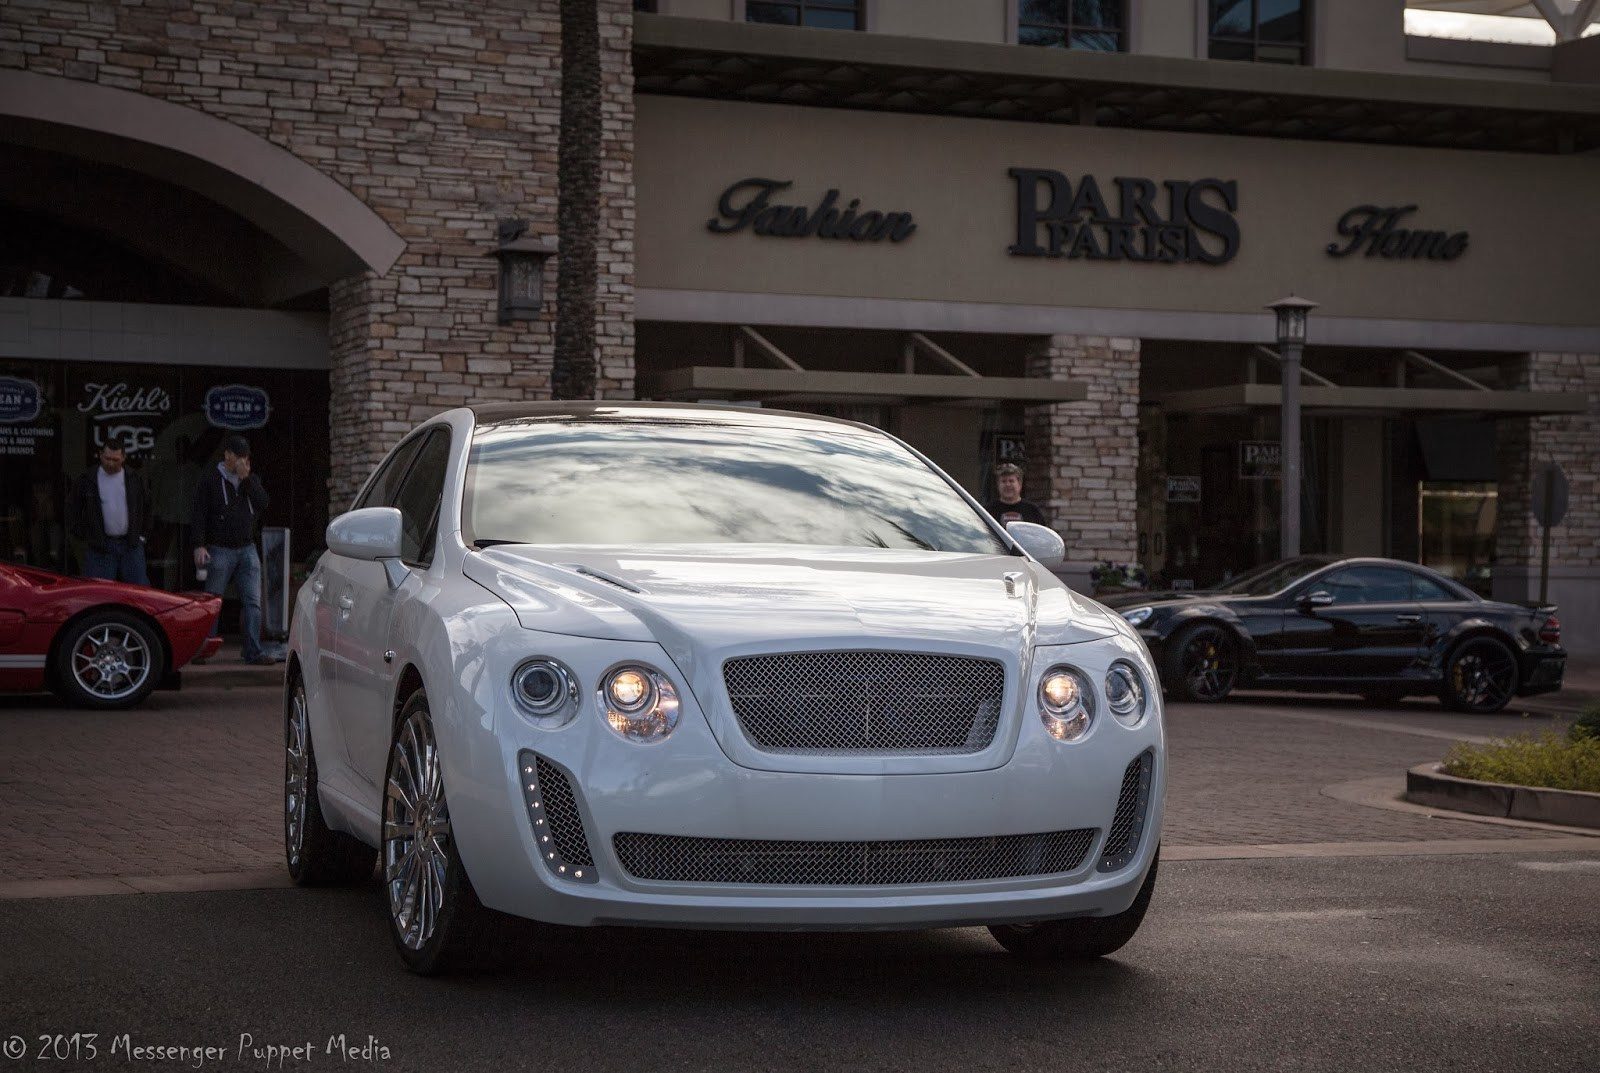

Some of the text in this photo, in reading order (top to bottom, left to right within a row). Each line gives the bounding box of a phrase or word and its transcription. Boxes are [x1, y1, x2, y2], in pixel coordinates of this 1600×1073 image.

[706, 177, 918, 243] Fashion
[1007, 167, 1241, 267] PARIS
[1326, 203, 1470, 262] Home
[1046, 222, 1190, 264] PARIS
[77, 382, 171, 413] Kiehl's
[92, 425, 155, 453] UGG
